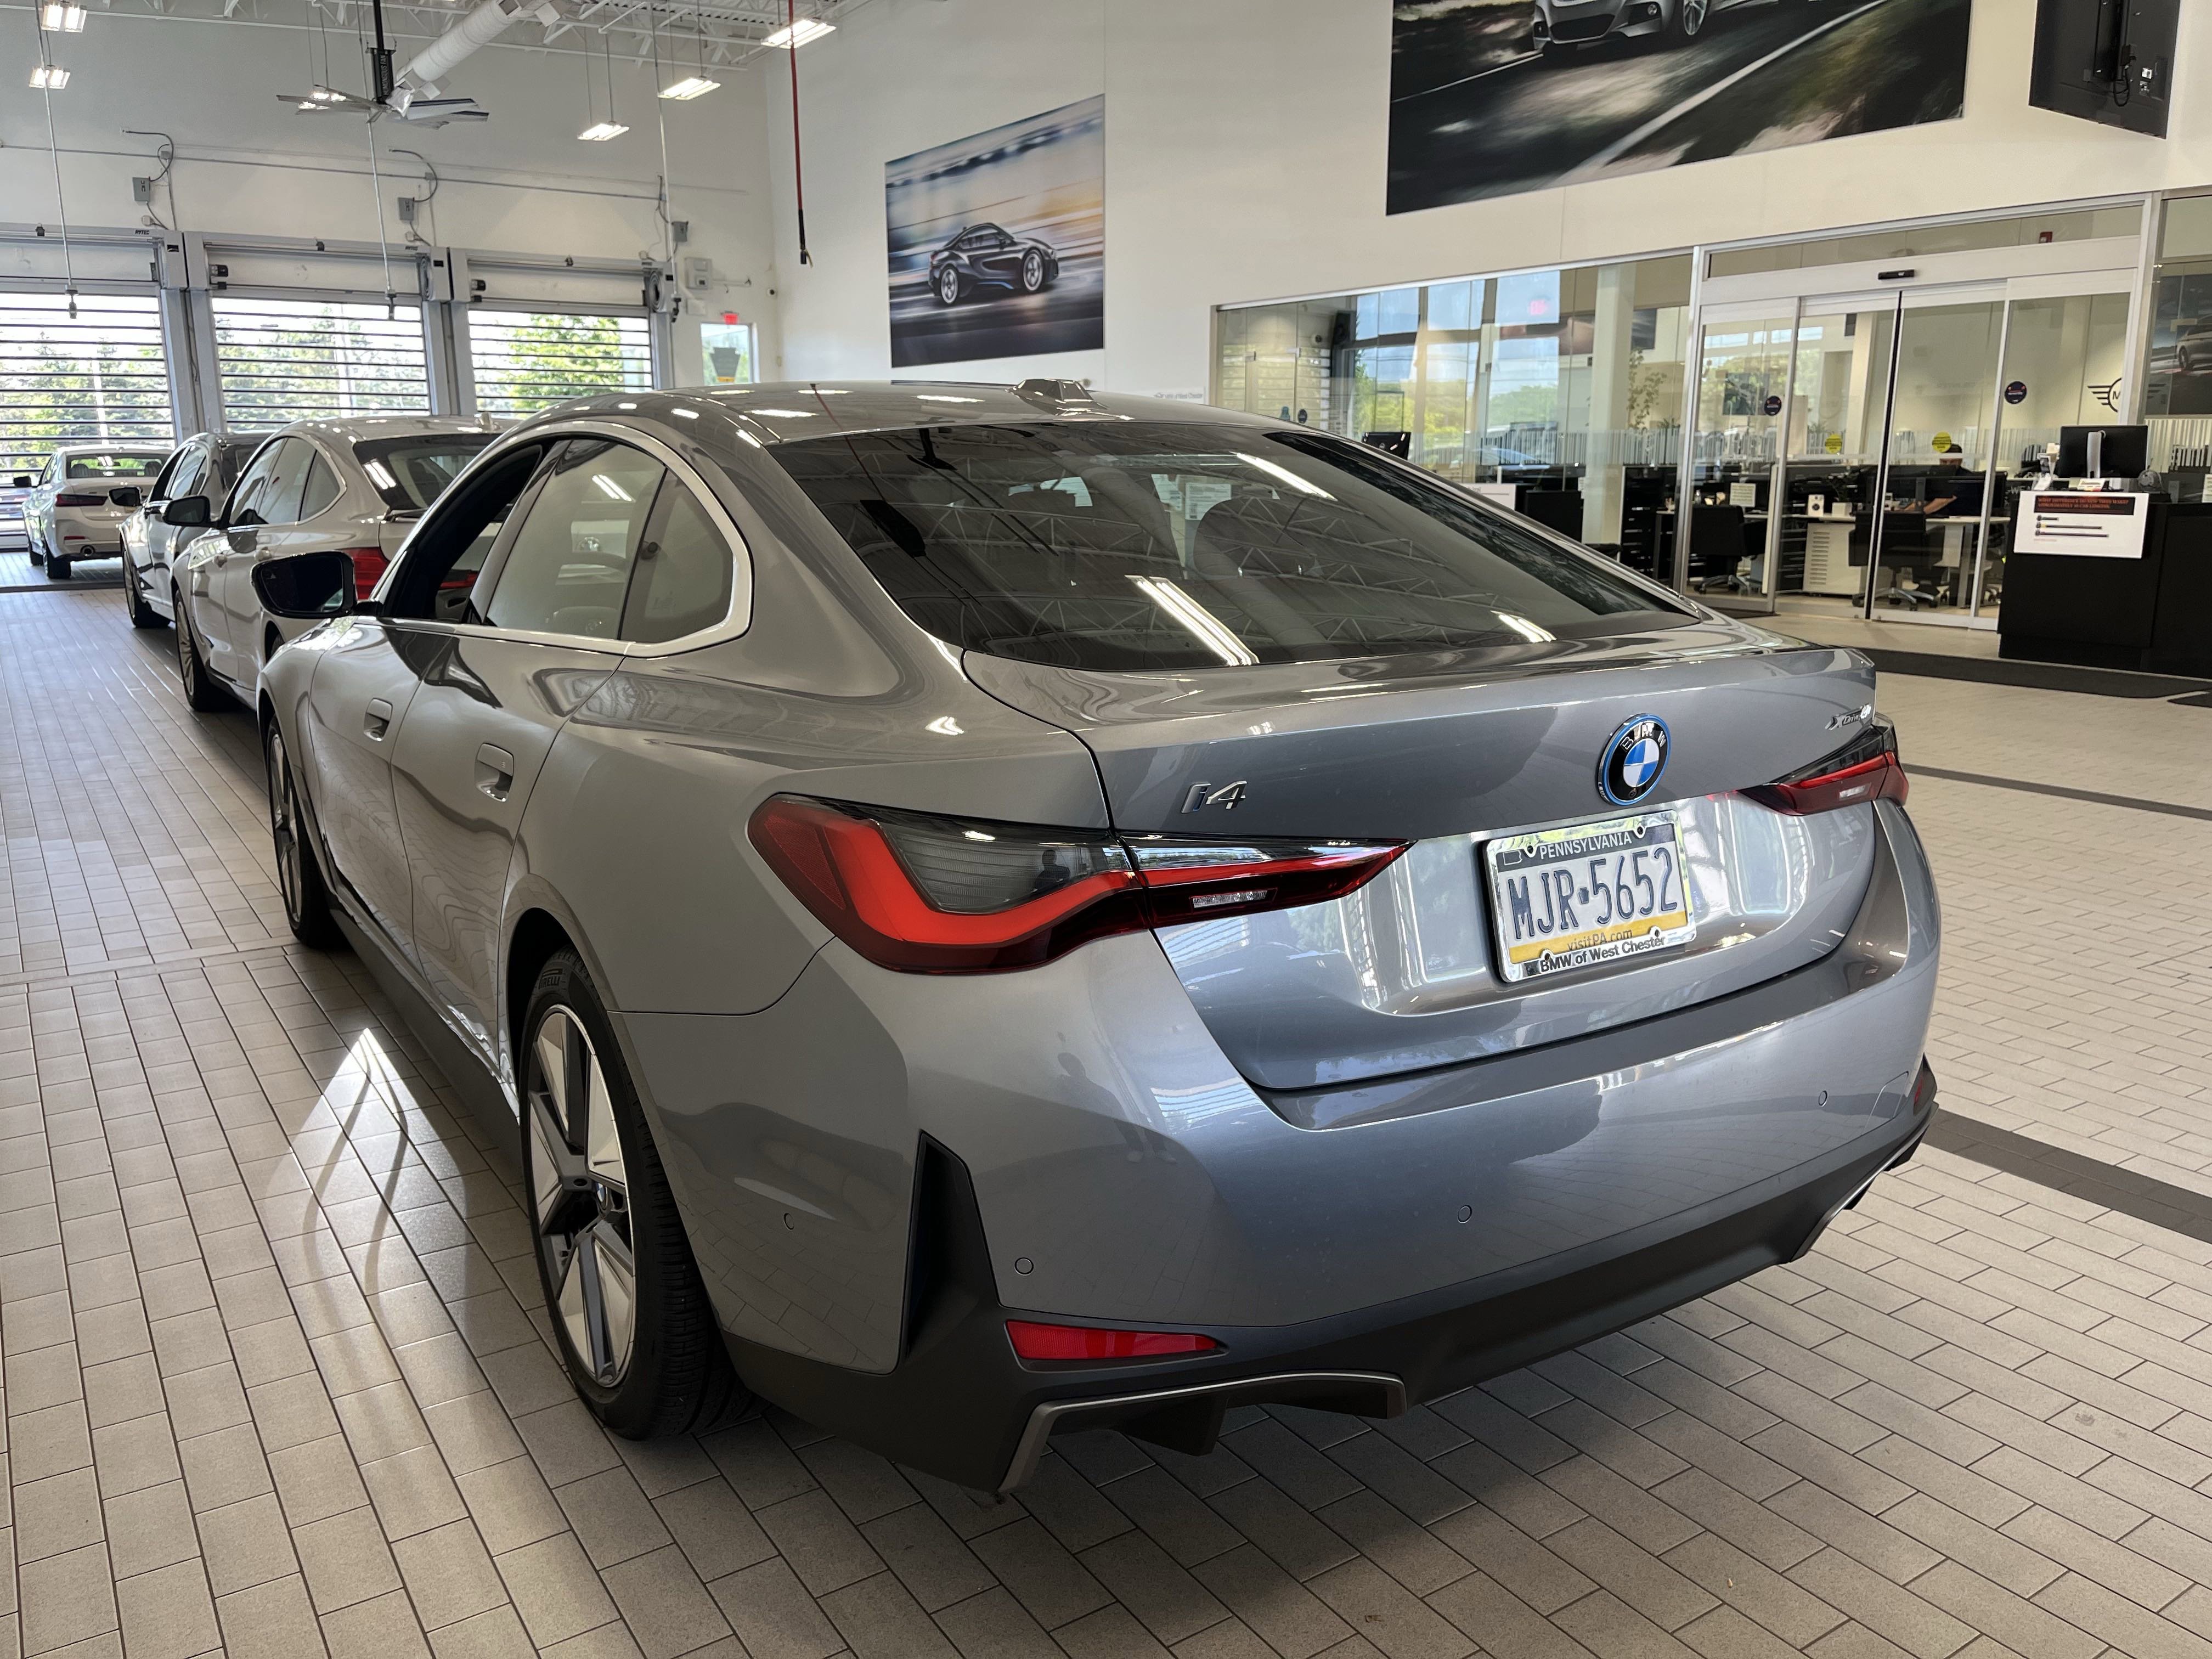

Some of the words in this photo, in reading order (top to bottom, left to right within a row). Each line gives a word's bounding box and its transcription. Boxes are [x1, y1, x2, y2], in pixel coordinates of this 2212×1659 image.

[1620, 722, 1667, 751] BMW
[1539, 831, 1632, 860] PENNSYLVANIA
[1539, 953, 1572, 973] BMW
[1575, 951, 1587, 964] of
[1589, 945, 1619, 961] West
[1622, 936, 1666, 953] Chester
[1567, 929, 1633, 951] visitPA.com
